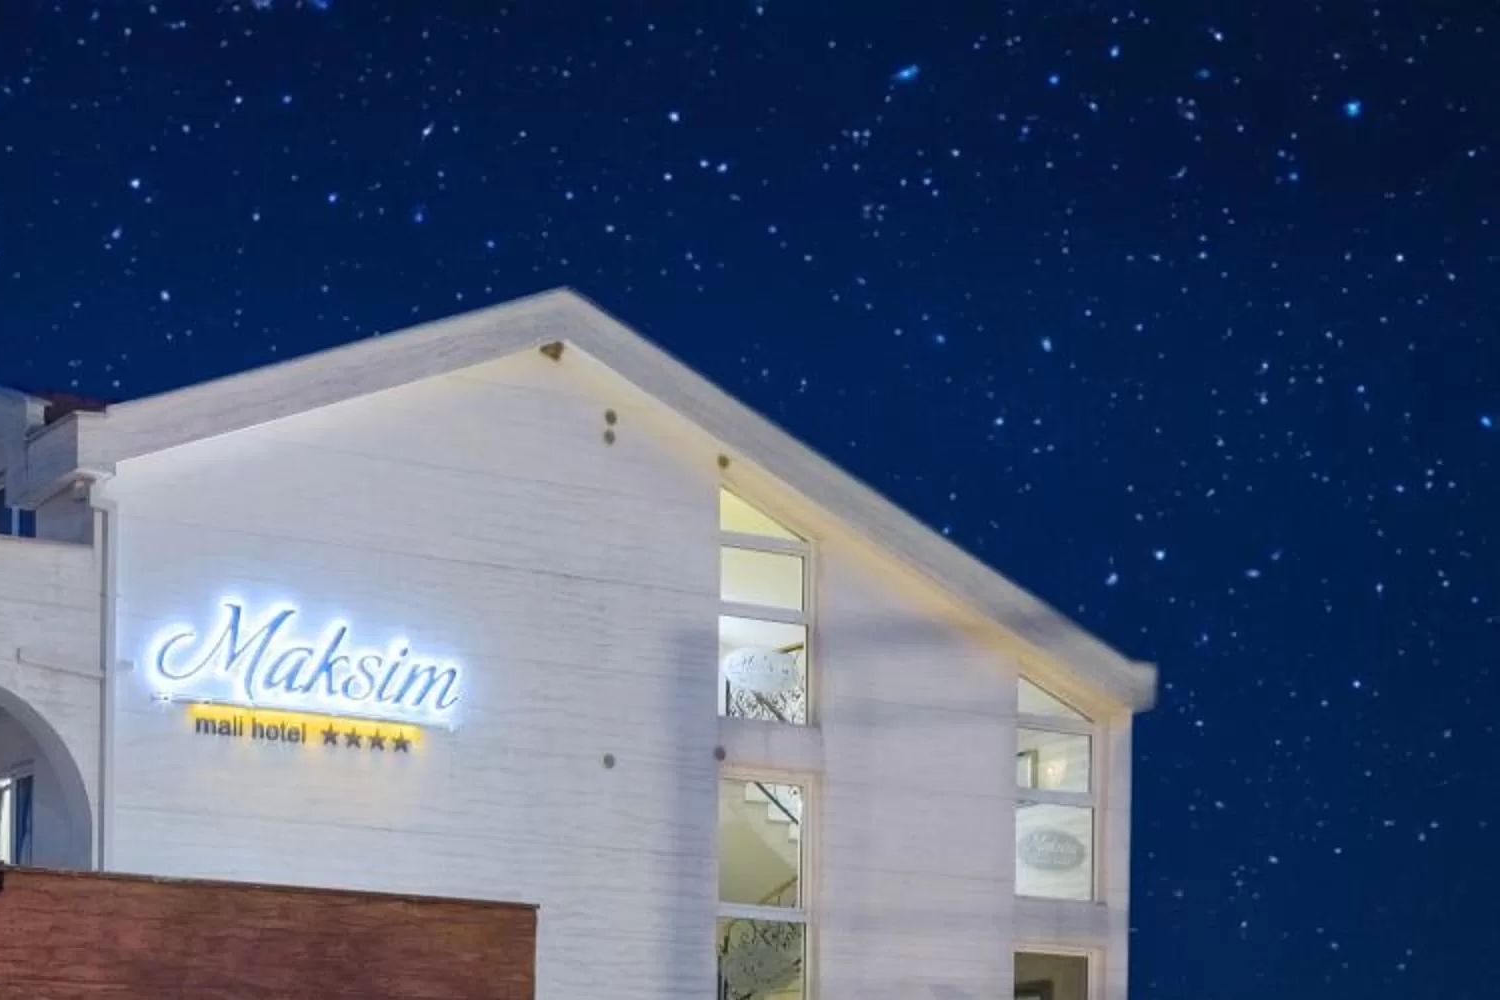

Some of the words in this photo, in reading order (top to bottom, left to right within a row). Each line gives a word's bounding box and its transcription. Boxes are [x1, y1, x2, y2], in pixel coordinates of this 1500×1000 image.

[156, 603, 460, 710] Maksim
[194, 716, 244, 737] mali
[251, 717, 307, 744] hotel
